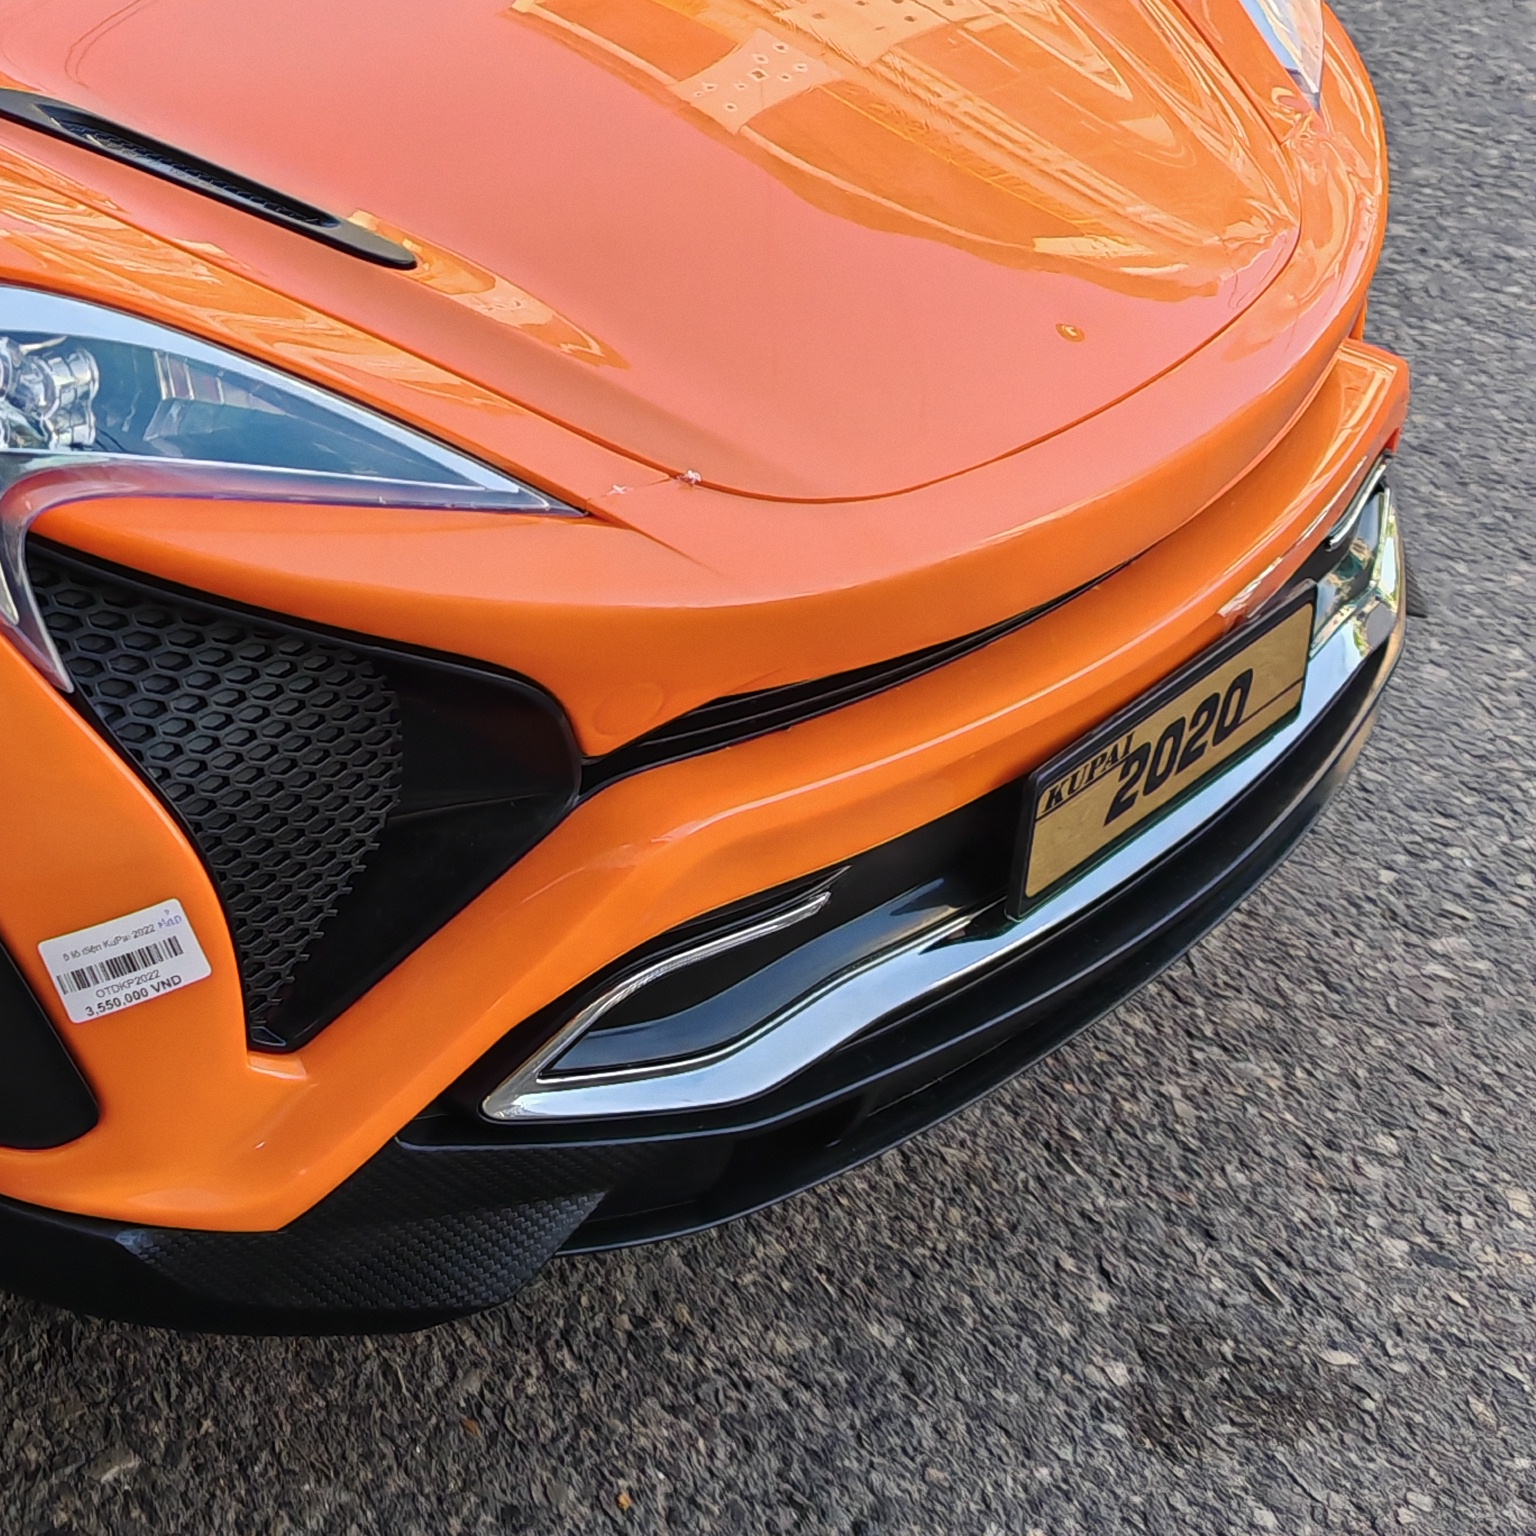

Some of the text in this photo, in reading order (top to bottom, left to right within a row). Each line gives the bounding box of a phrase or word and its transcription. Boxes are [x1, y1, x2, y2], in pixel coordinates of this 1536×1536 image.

[1103, 667, 1253, 827] 2020
[1042, 731, 1136, 814] KUPAI
[131, 923, 156, 939] 2022
[85, 974, 182, 1016] 3,550,000 VND
[95, 969, 161, 998] OTDKP2022
